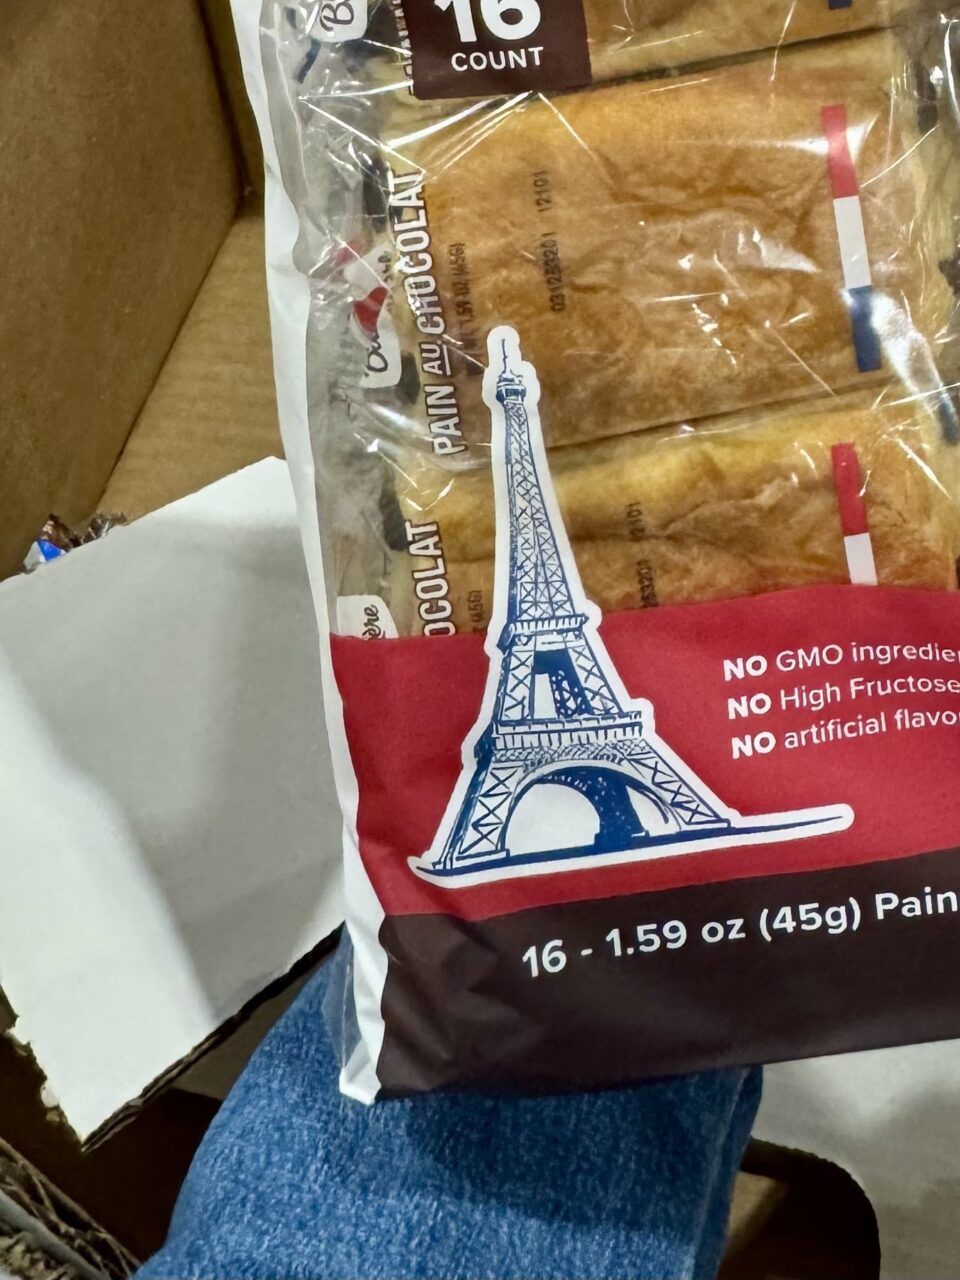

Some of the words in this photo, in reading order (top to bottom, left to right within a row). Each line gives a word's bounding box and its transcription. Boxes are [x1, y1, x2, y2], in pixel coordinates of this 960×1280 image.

[450, 46, 544, 72] COUNT
[388, 168, 445, 337] CHOCOLAT
[420, 340, 451, 377] AU
[424, 383, 467, 456] PAIN
[404, 519, 457, 637] OCOLAT
[723, 655, 768, 681] NO
[775, 644, 843, 672] GMO
[727, 692, 772, 720] NO
[780, 681, 841, 712] High
[849, 675, 960, 700] Fructose
[731, 731, 777, 760] NO
[784, 709, 887, 750] artificial
[522, 939, 568, 979] 16
[604, 920, 688, 958] 1.59
[701, 917, 746, 945] oz
[758, 896, 861, 942] (45g)
